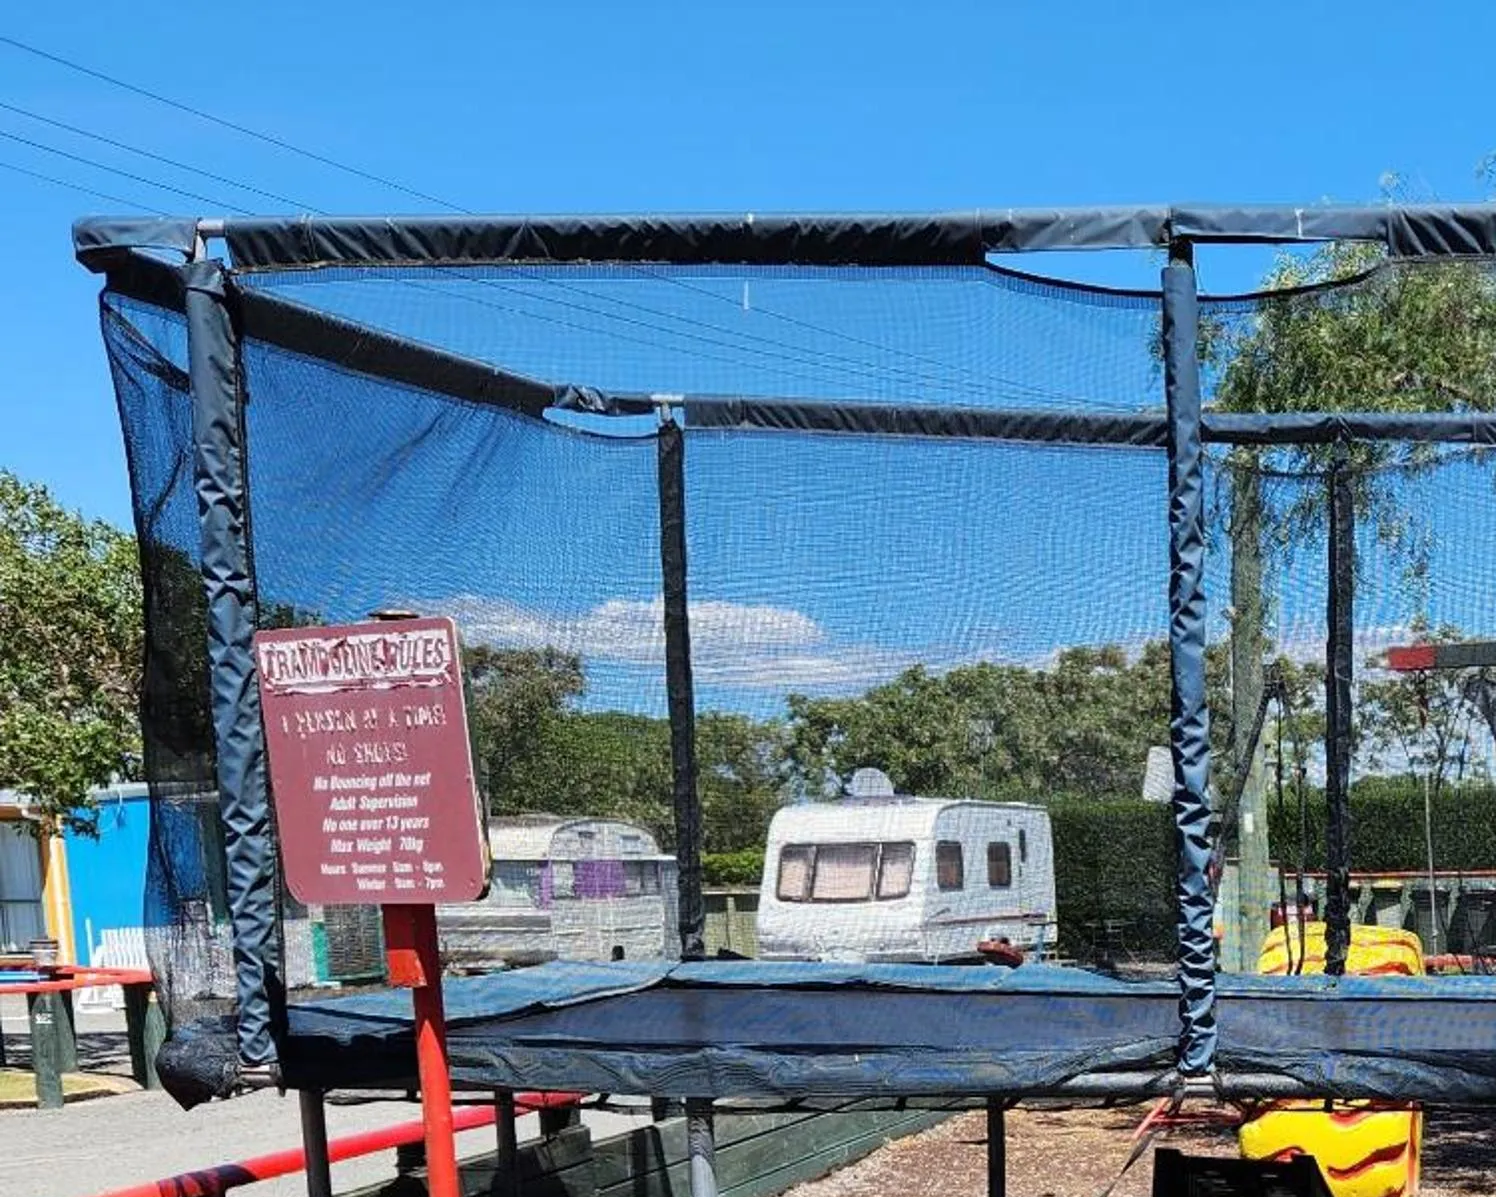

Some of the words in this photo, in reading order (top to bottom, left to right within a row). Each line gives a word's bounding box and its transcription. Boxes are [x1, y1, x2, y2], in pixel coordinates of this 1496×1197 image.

[313, 775, 328, 790] No
[330, 774, 377, 791] Bouncing
[378, 772, 393, 787] off
[394, 772, 411, 787] the
[413, 771, 431, 786] net
[330, 795, 356, 810] Adult
[358, 794, 418, 812] Supervision
[322, 818, 338, 832] No
[338, 819, 358, 831] one
[360, 818, 383, 831] over
[385, 816, 399, 829] 13
[400, 816, 430, 832] years
[330, 838, 354, 853] Max
[356, 837, 392, 854] Weight
[357, 877, 386, 890] Winter
